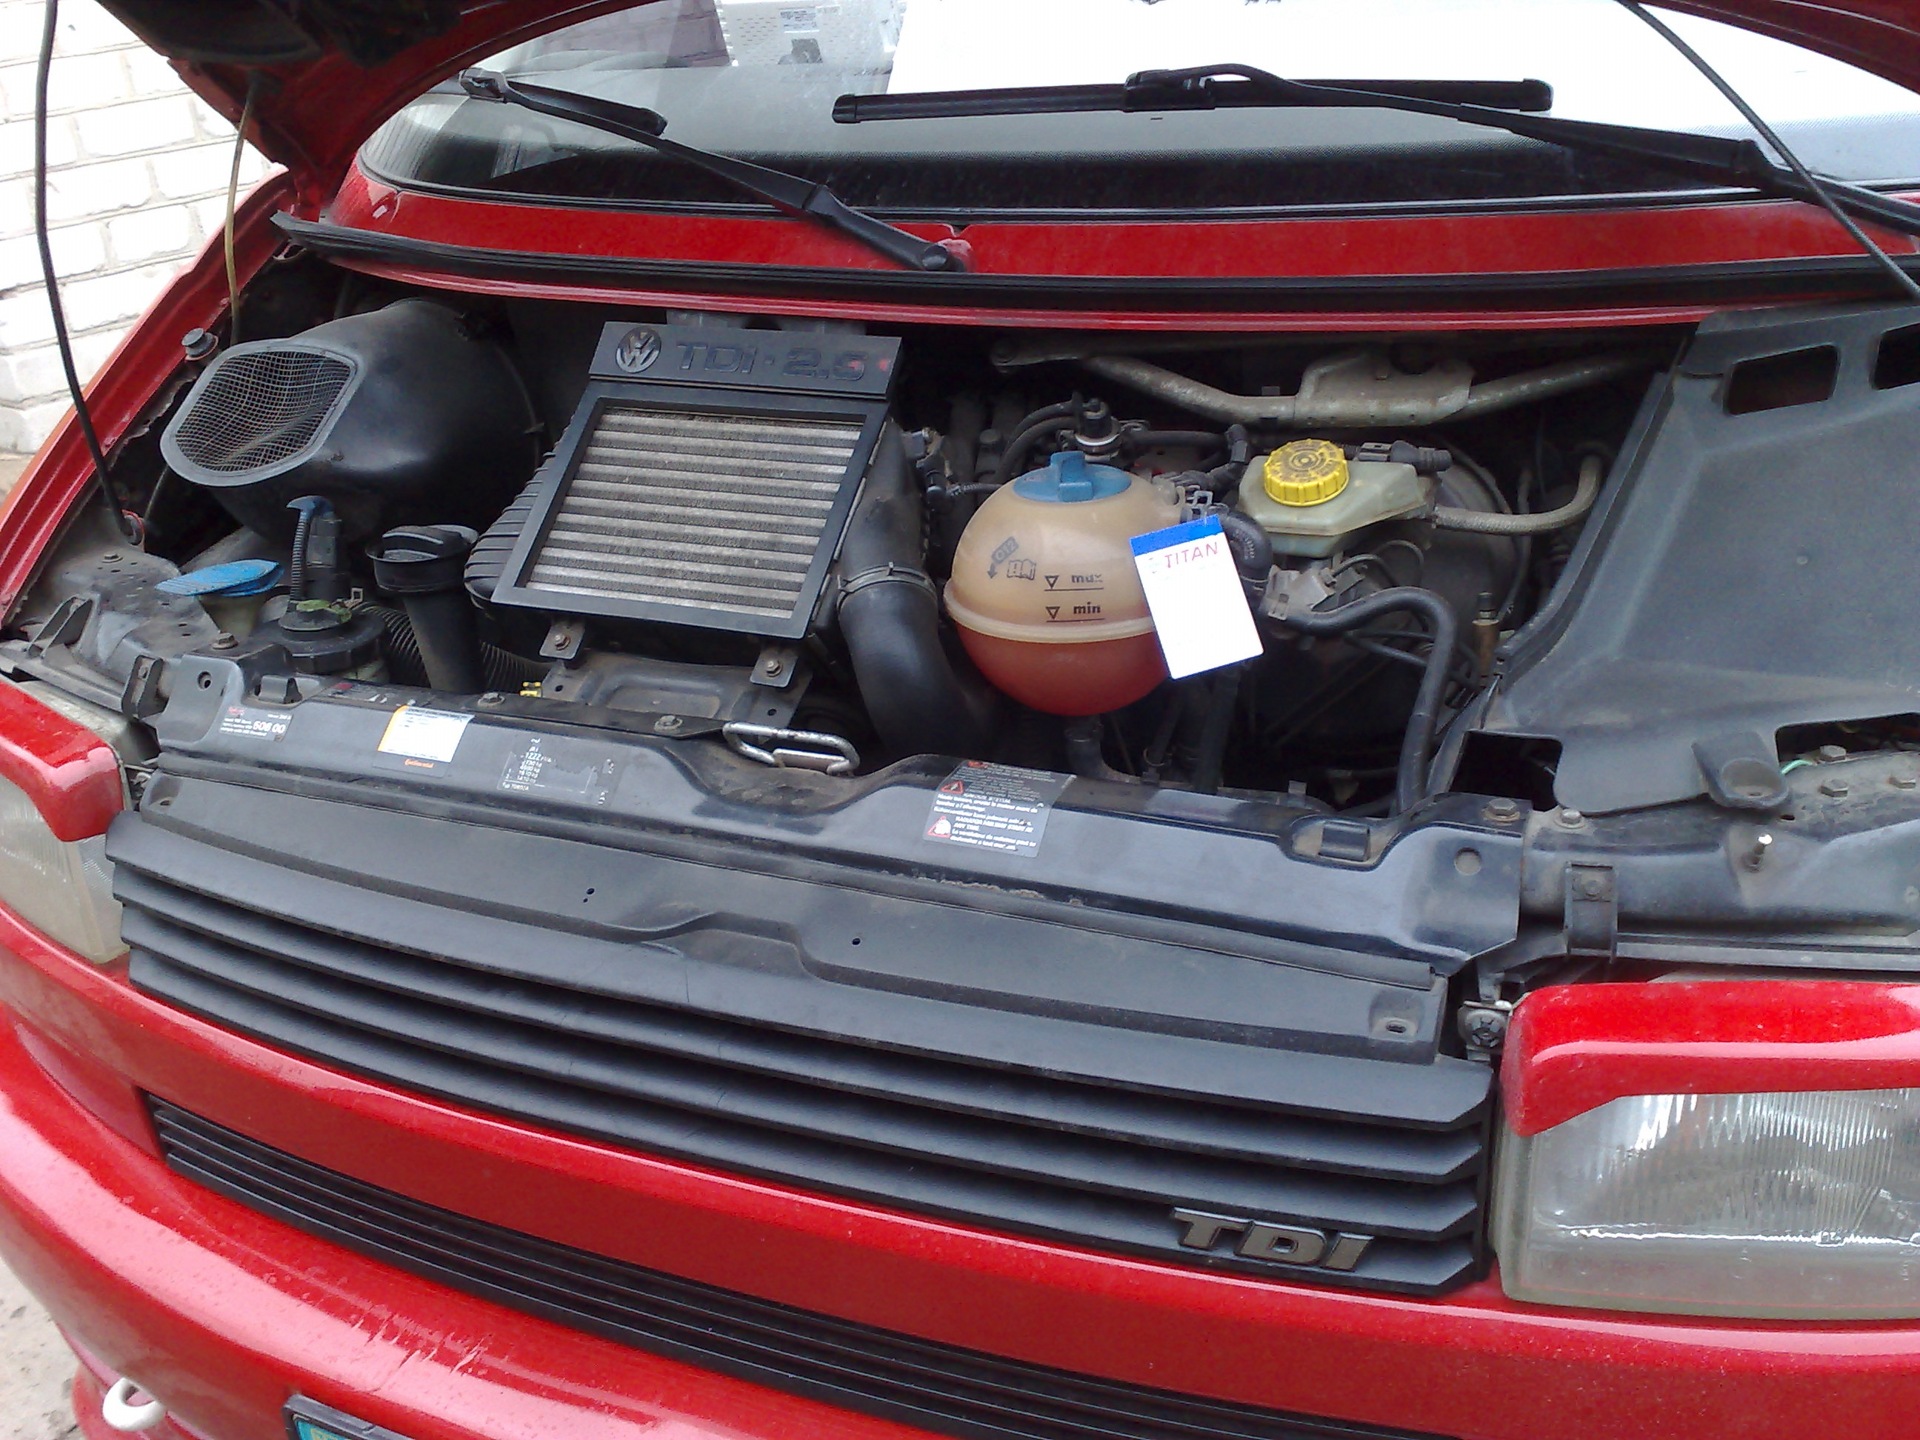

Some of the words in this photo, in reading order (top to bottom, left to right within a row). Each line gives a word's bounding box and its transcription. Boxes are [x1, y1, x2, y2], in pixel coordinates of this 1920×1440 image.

[1164, 542, 1219, 568] TITAN
[1073, 601, 1102, 614] min
[1173, 1207, 1375, 1271] TDI
